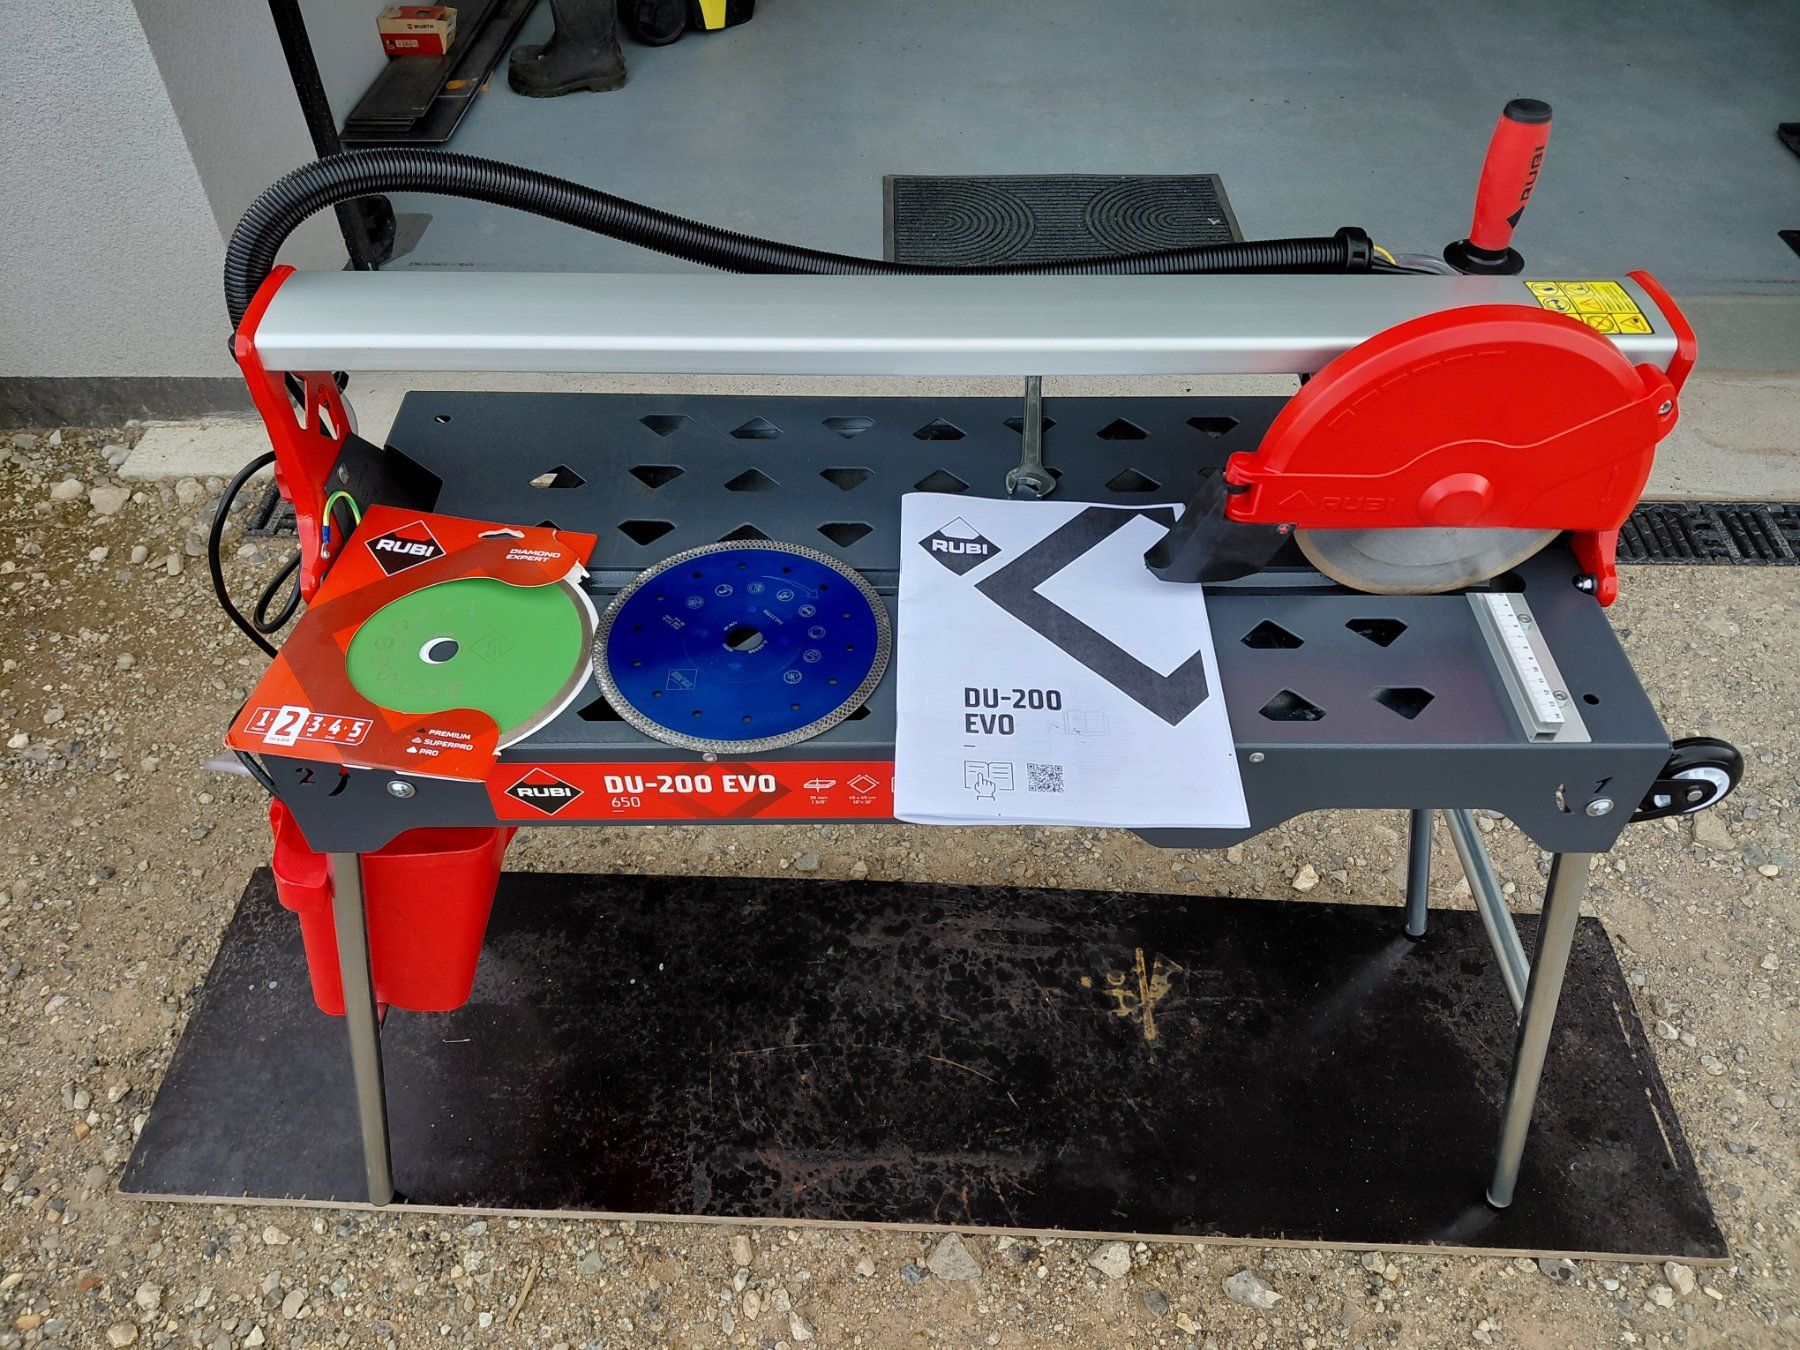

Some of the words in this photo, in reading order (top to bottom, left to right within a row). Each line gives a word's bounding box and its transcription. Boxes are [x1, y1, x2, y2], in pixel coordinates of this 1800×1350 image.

[1520, 146, 1545, 201] RUBI
[376, 538, 435, 557] RUBI
[510, 548, 561, 558] DIAMOND
[931, 538, 988, 555] RUBI
[505, 554, 550, 562] EXPERT
[964, 687, 1062, 711] DU-200
[256, 710, 271, 727] 1
[275, 710, 300, 736] 2
[307, 716, 325, 732] 3
[328, 719, 342, 735] 4
[348, 721, 365, 737] 5
[965, 713, 1015, 736] EVO
[428, 729, 471, 740] PREMIUM
[423, 739, 474, 751] SUPERPRO
[419, 748, 439, 757] PRO
[604, 775, 712, 794] DU-200
[722, 775, 776, 793] EVO
[516, 787, 572, 797] RUBI
[611, 796, 641, 808] 650
